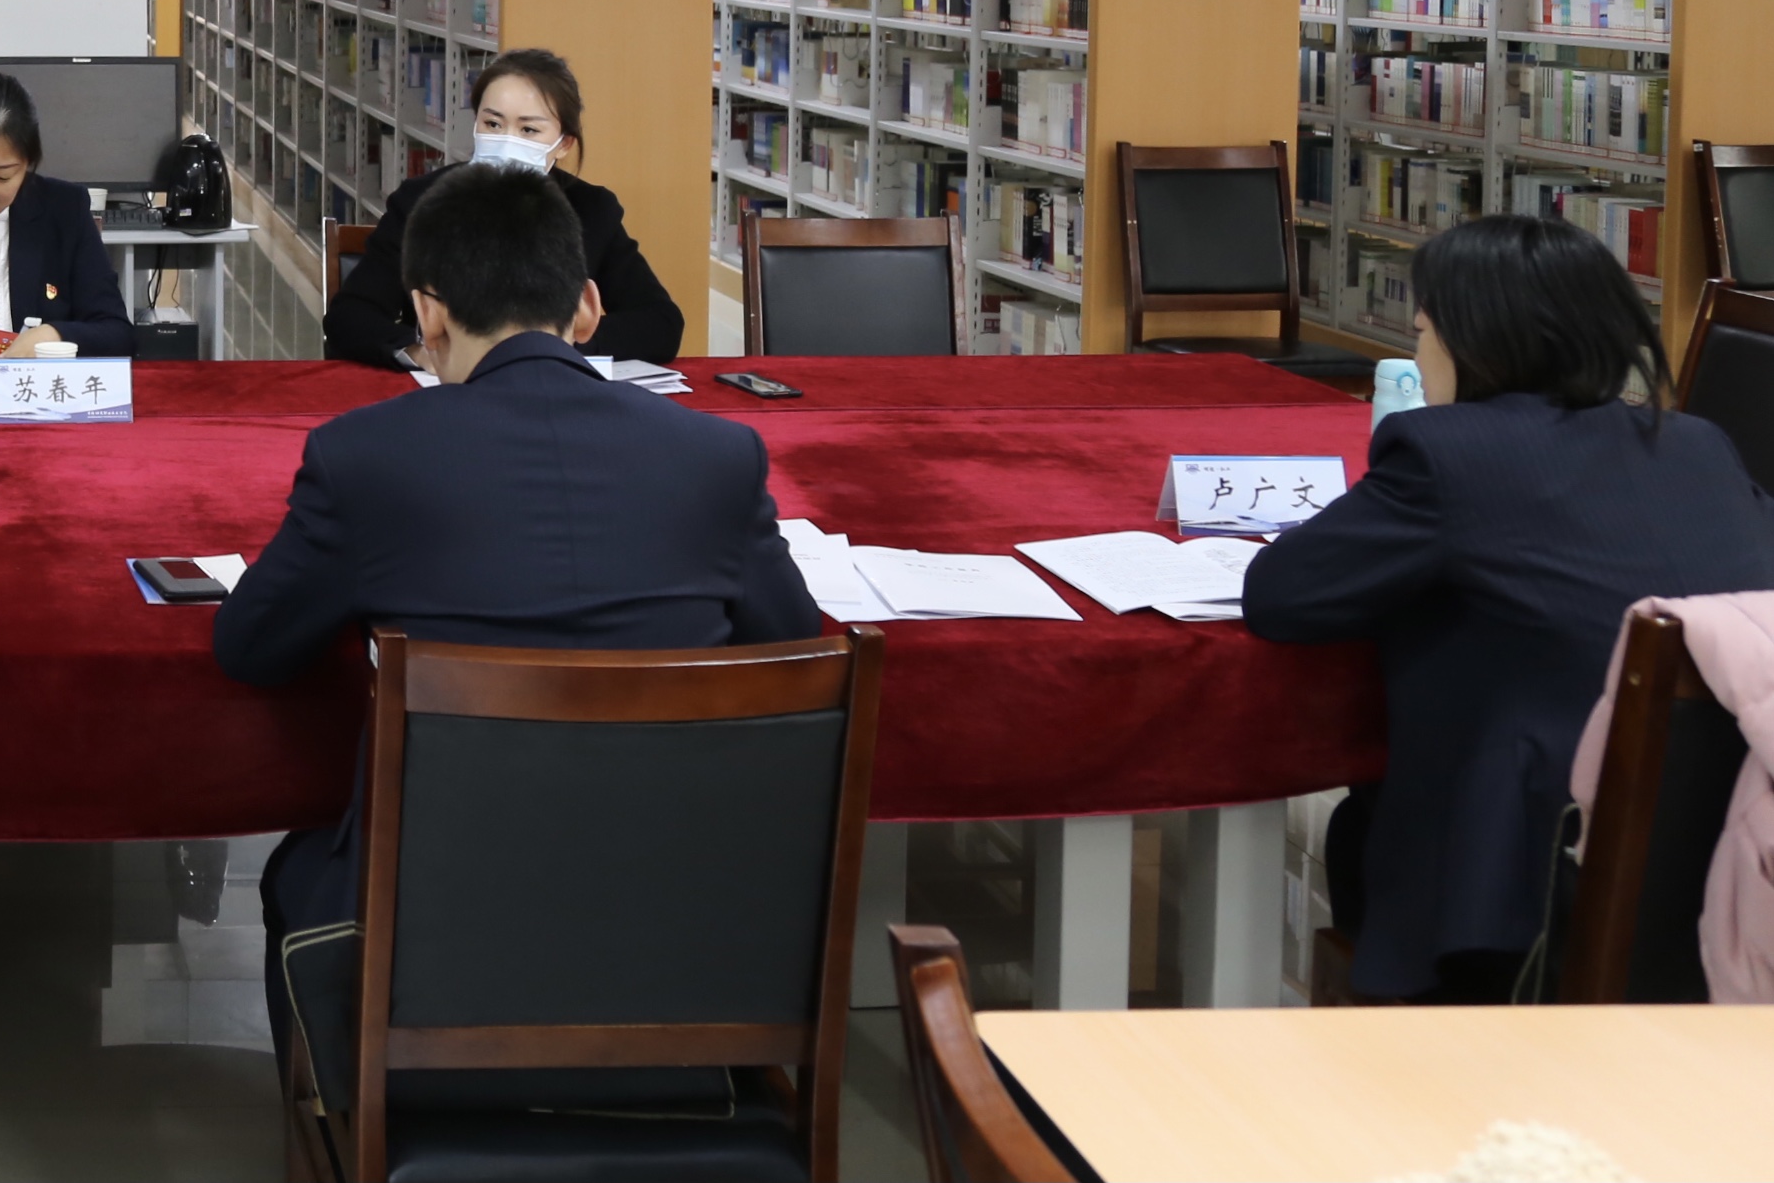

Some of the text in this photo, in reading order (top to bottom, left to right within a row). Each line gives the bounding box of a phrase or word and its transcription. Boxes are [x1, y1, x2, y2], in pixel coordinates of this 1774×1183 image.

[12, 374, 108, 405] 苏春年
[1208, 476, 1326, 511] 卢广文
